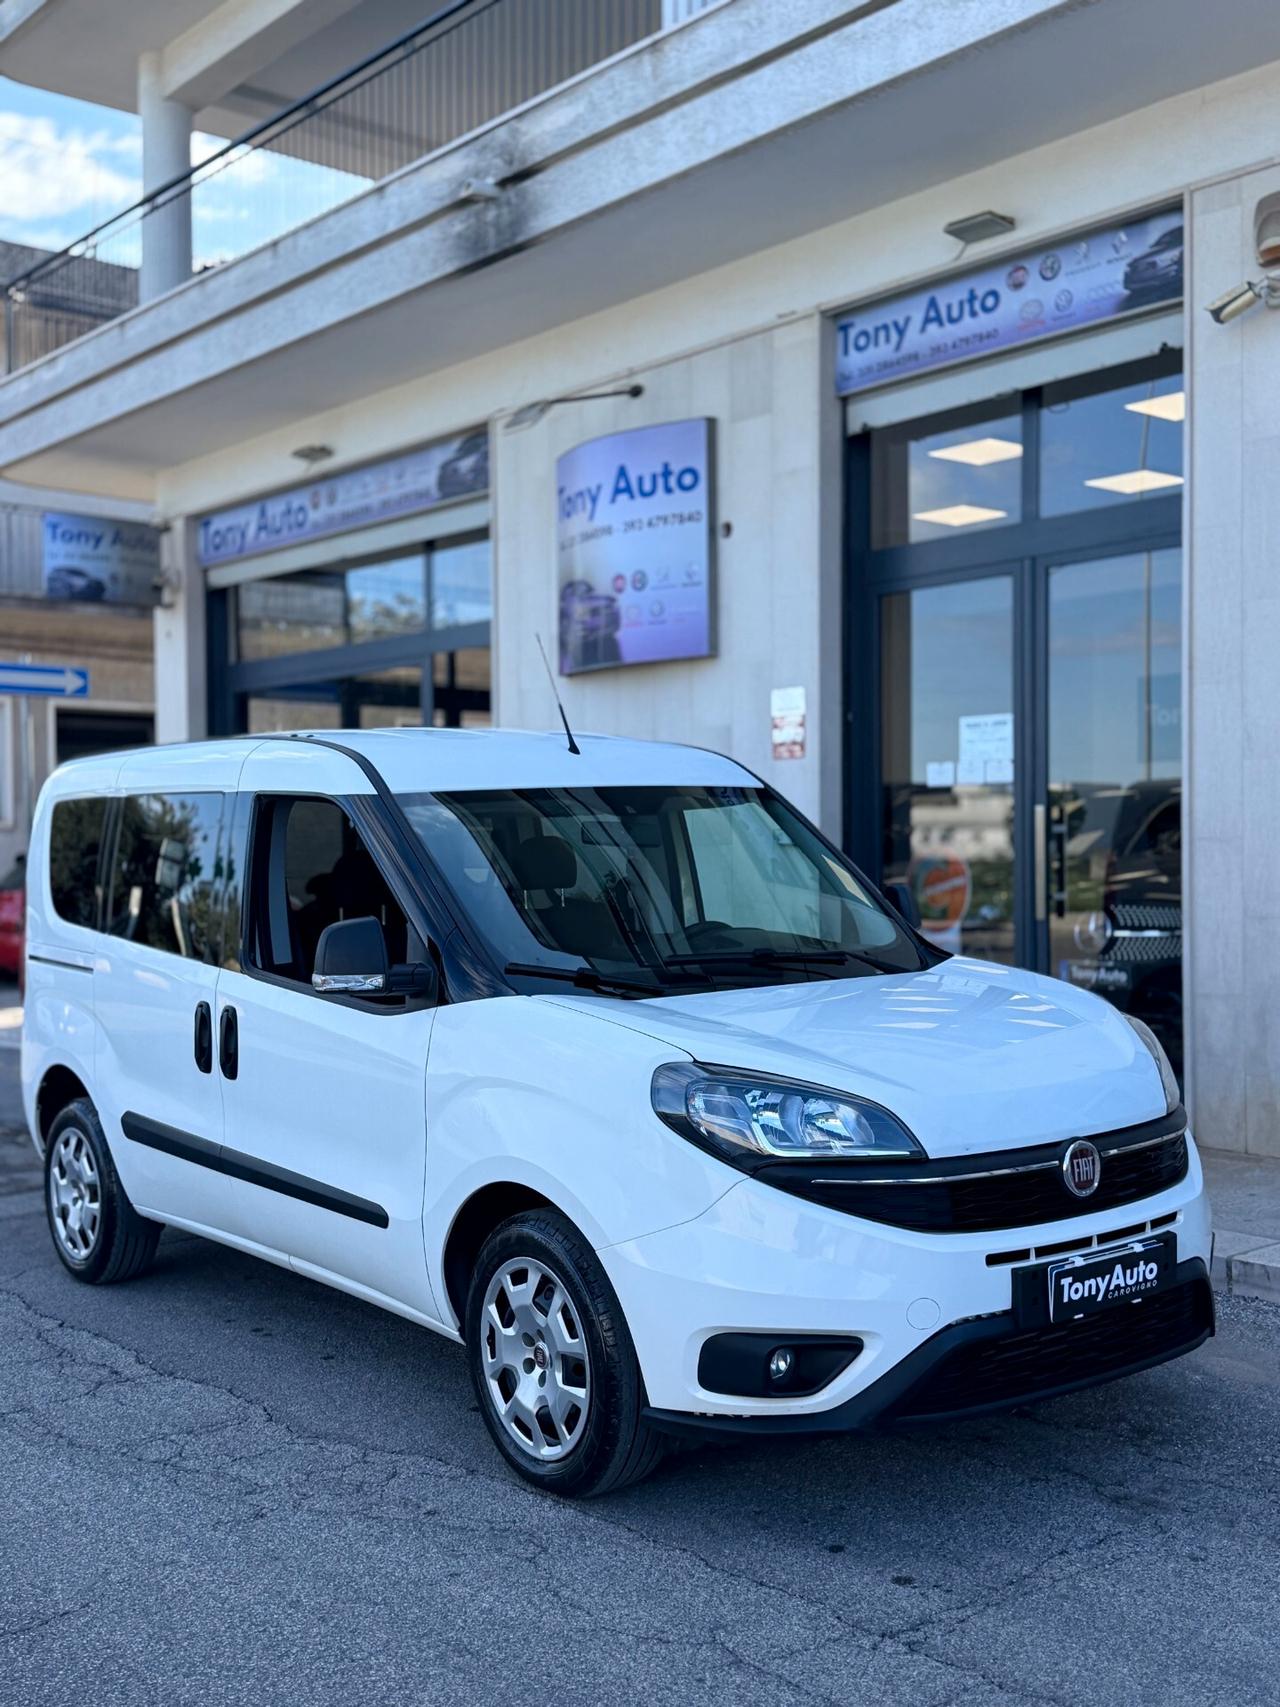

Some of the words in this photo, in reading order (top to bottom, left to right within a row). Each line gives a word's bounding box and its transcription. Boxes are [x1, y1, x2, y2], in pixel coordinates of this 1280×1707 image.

[838, 315, 911, 357] Tony
[919, 288, 1001, 333] Auto
[609, 462, 699, 504] Auto
[46, 521, 104, 550] Tony
[203, 518, 248, 555] Tony
[255, 502, 309, 535] Auto
[1072, 1156, 1094, 1182] FIAT
[1061, 1261, 1158, 1302] TonyAuto
[1107, 1279, 1158, 1299] CAROVIGNO
